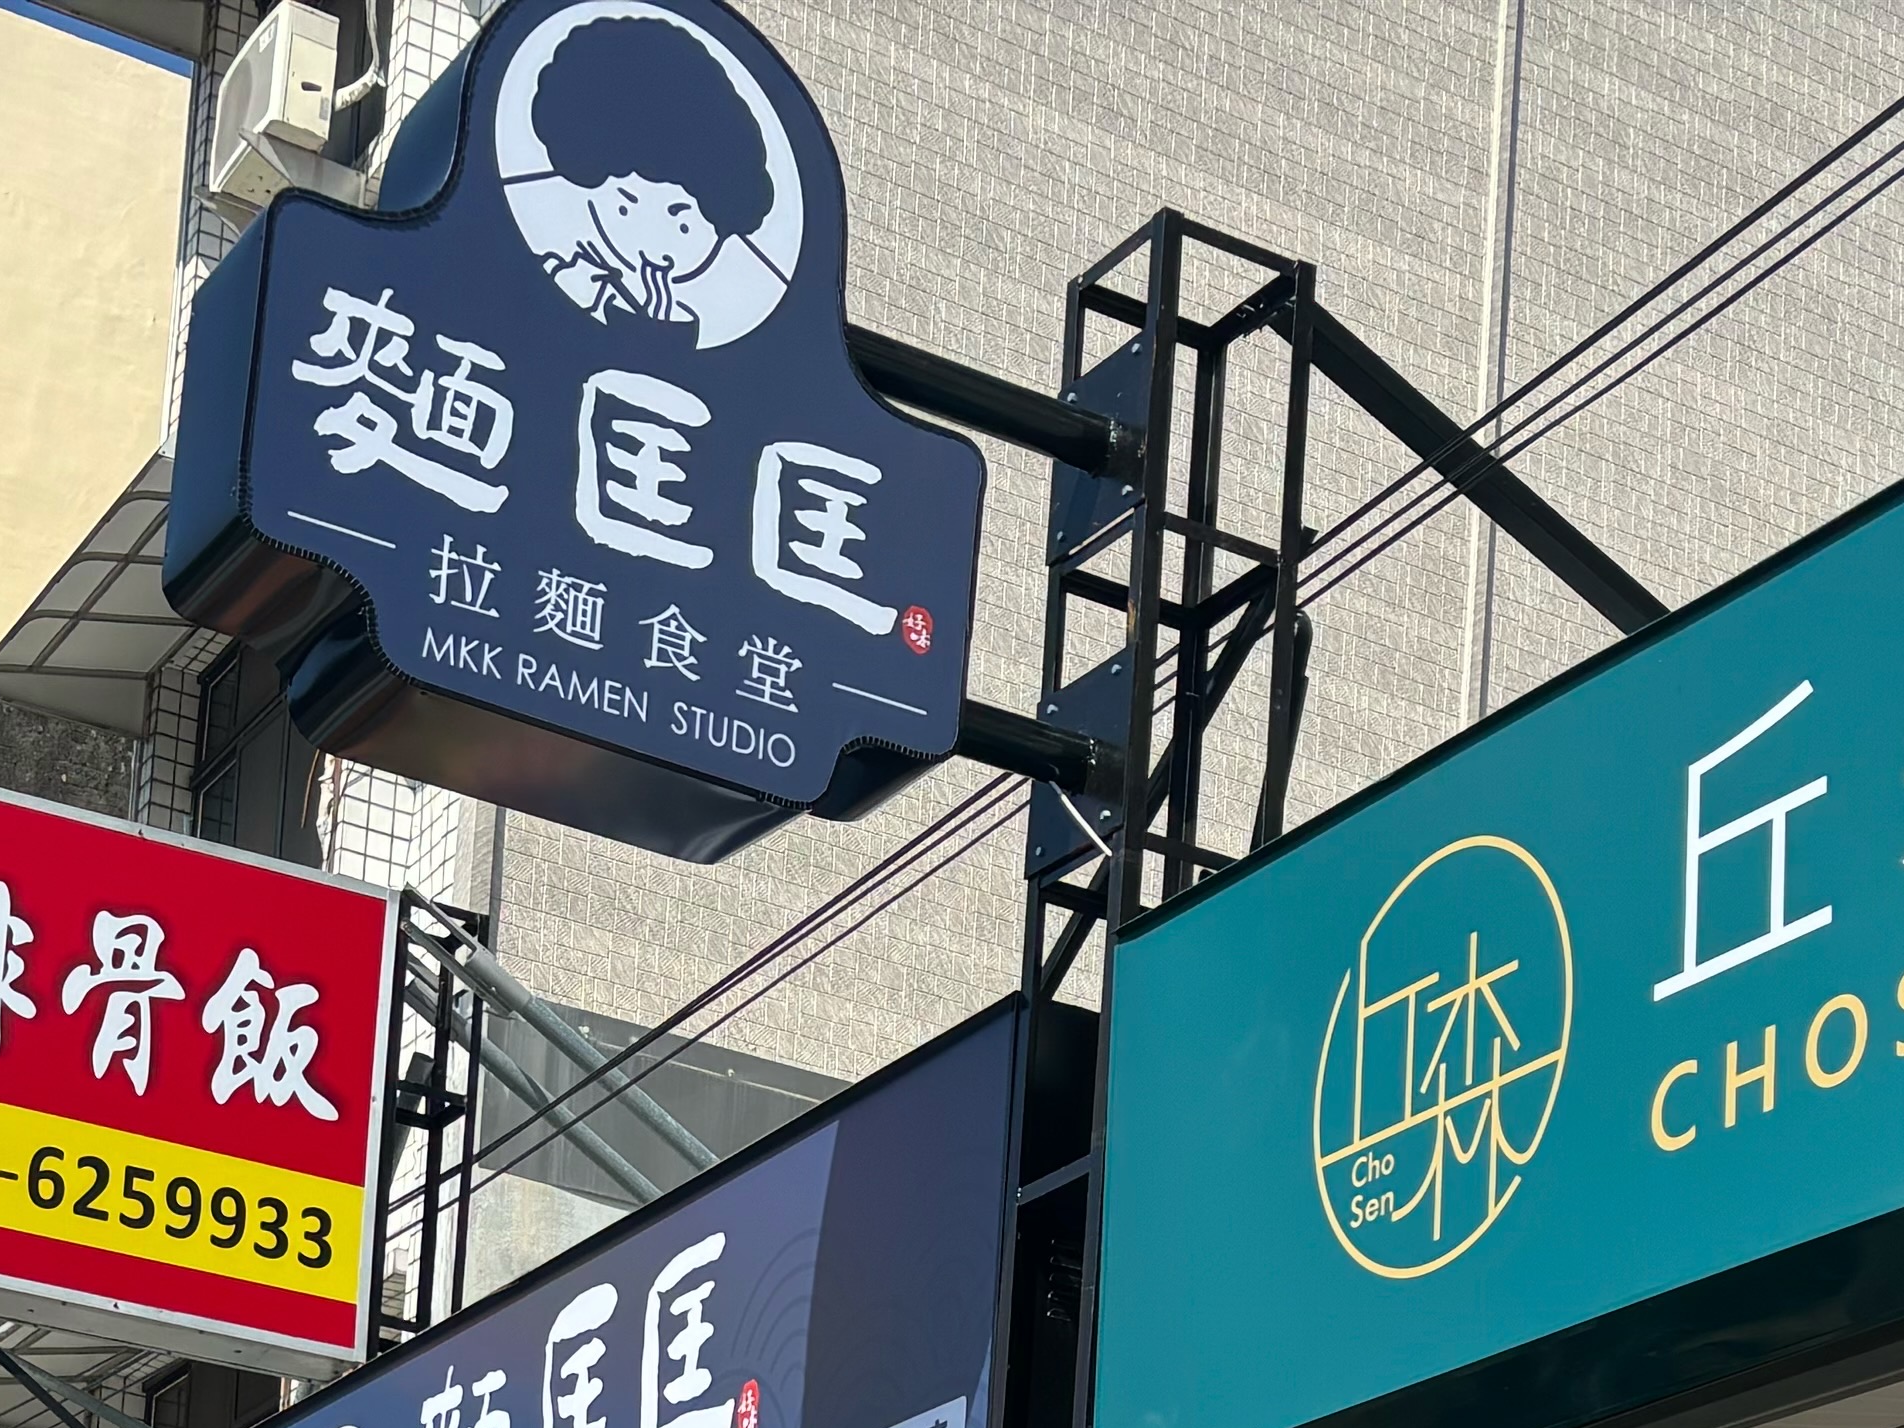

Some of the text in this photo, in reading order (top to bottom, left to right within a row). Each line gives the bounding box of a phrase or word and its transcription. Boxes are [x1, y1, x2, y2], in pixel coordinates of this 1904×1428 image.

[291, 286, 897, 635] 麵匡匡
[429, 533, 803, 715] 拉麵食堂
[422, 627, 798, 770] MKK RAMEN STUDIO
[1349, 1190, 1395, 1229] Sen
[1351, 1151, 1395, 1189] Cho
